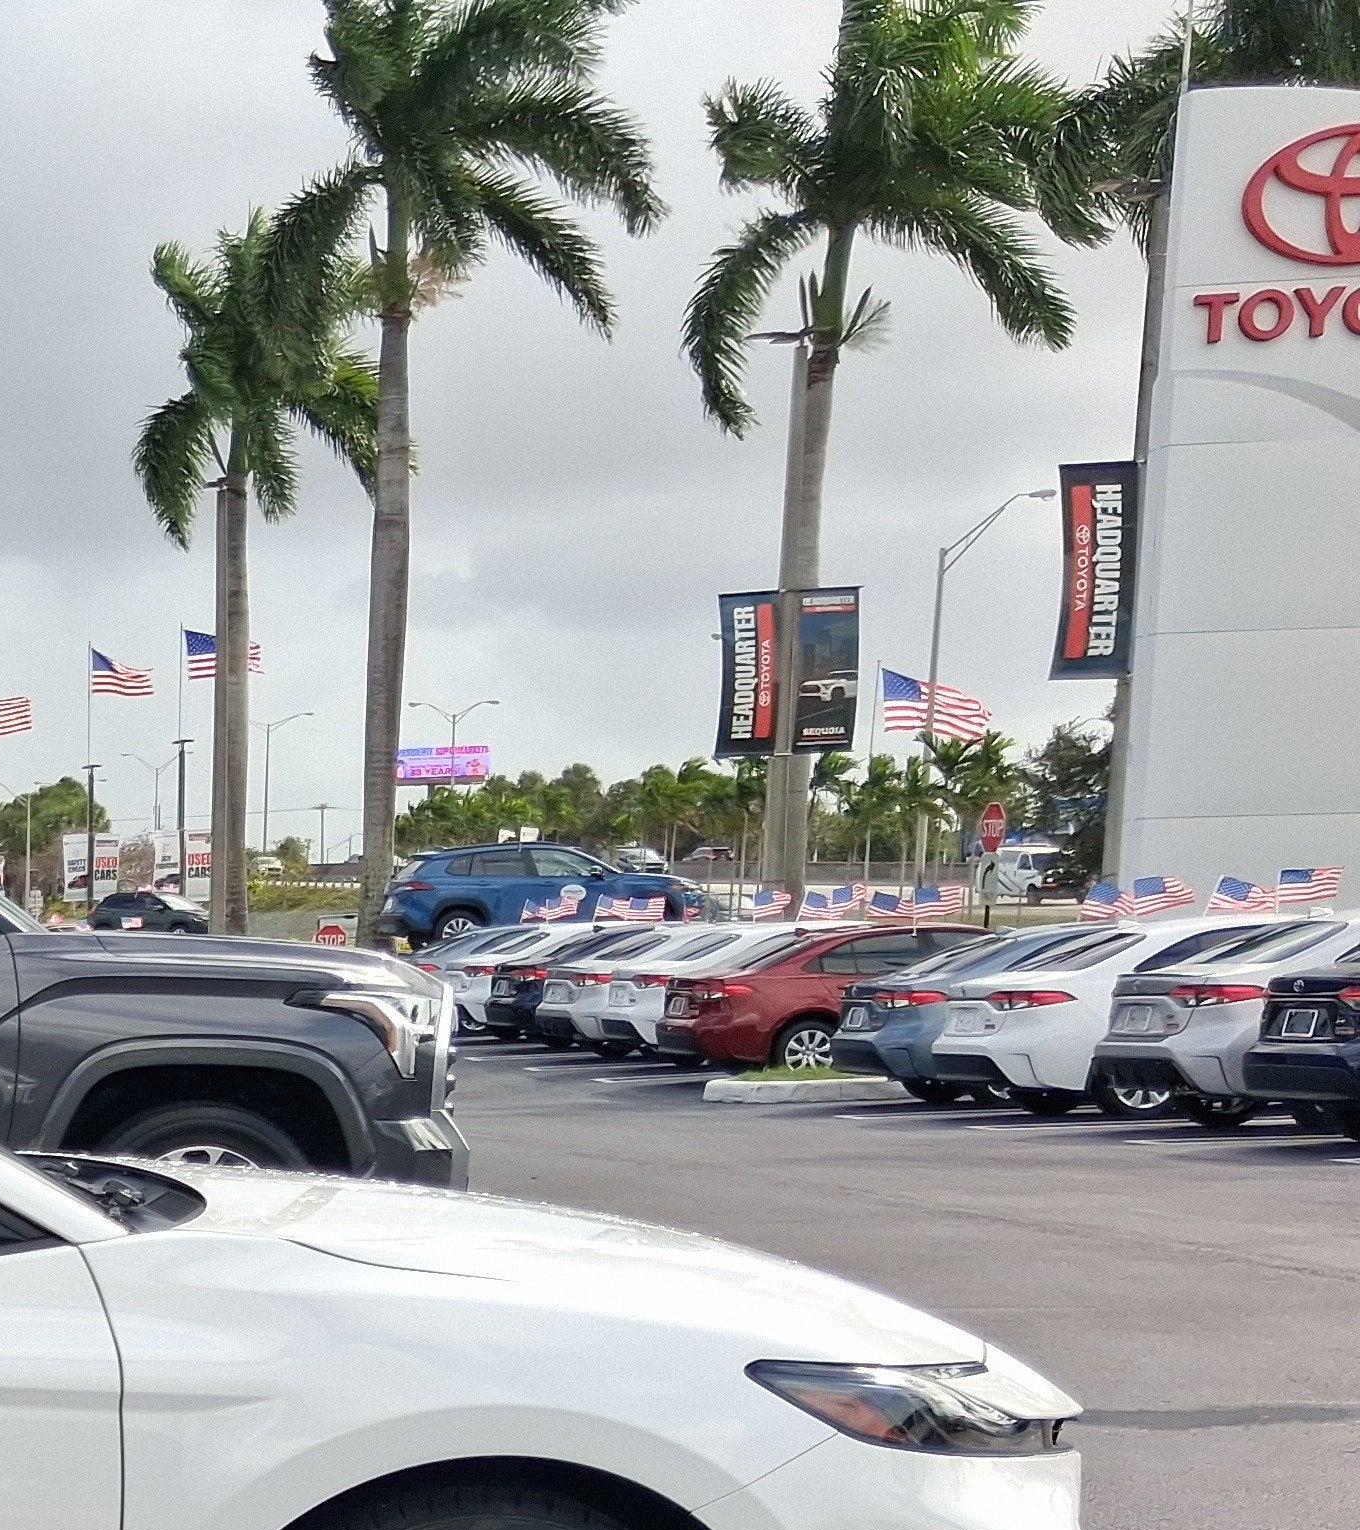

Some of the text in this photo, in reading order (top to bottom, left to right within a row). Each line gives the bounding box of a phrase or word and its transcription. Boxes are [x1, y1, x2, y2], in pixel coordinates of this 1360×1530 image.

[1086, 484, 1123, 657] HEADQUARTER
[1074, 548, 1089, 612] TOYOTA
[730, 606, 759, 740] HEADQUARTER
[760, 639, 771, 690] TOYOTA
[802, 727, 846, 737] SEQUOIA
[982, 820, 1004, 837] STOP
[95, 856, 118, 868] USED
[94, 870, 117, 881] CARS
[317, 934, 345, 946] STOP
